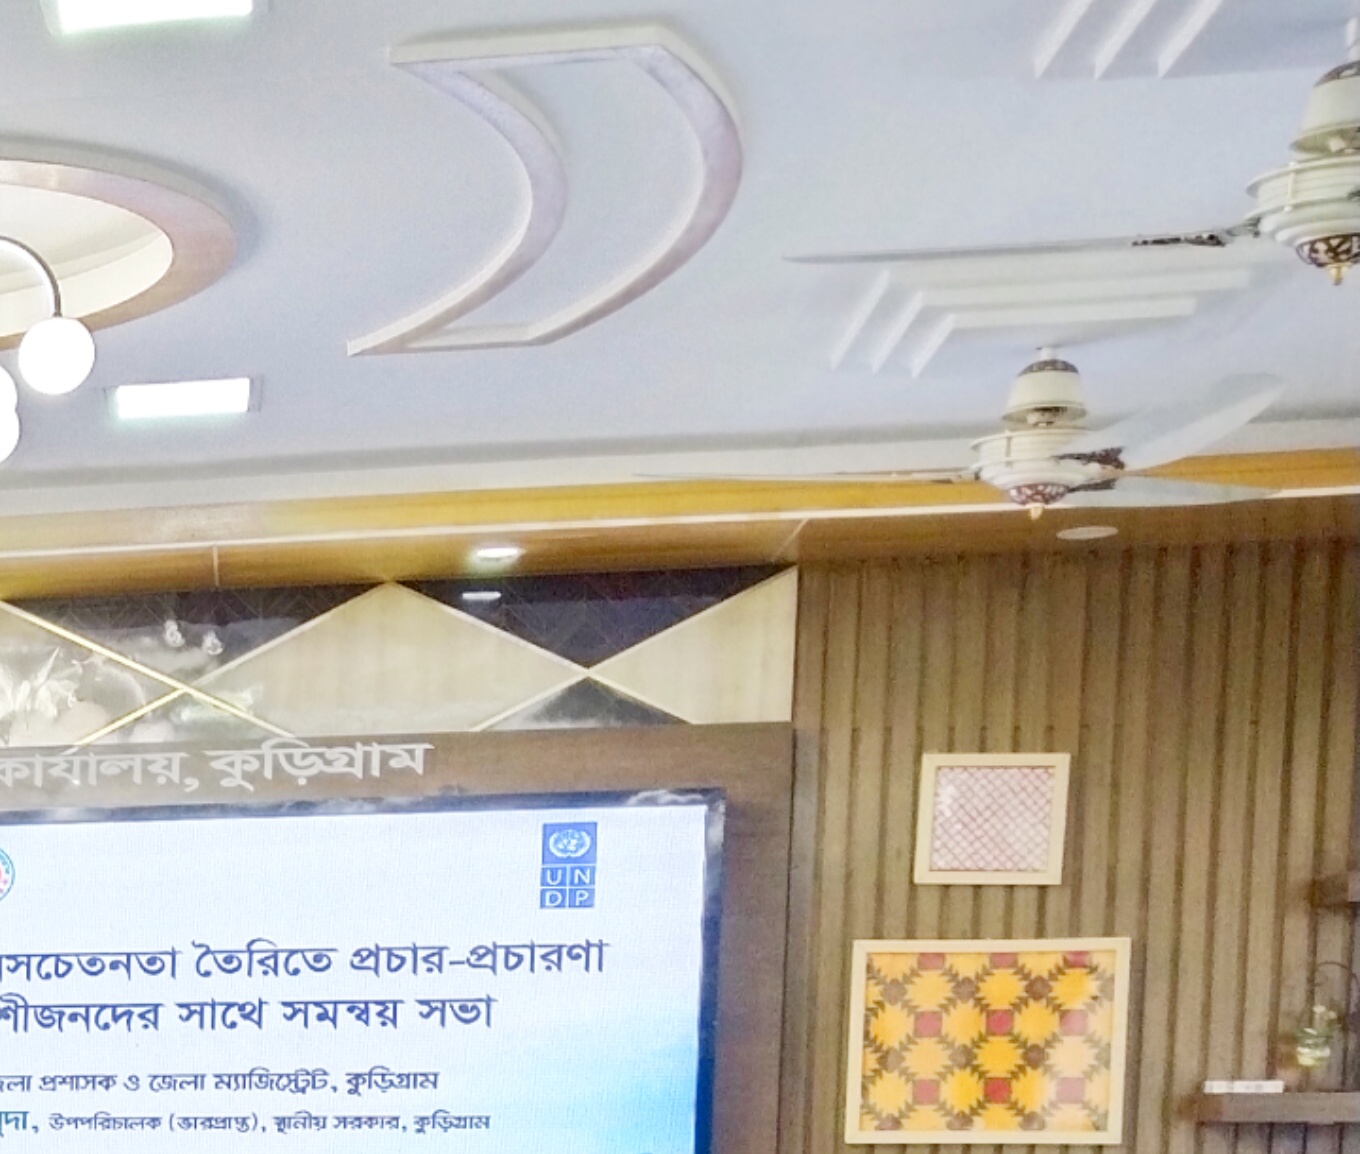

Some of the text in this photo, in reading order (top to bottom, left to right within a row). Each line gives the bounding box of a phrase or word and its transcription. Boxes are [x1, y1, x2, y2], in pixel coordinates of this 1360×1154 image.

[203, 739, 436, 793] কুড়িগ্রাম
[194, 938, 336, 977] তৈরিতে
[348, 938, 609, 976] প্রচার-প্রচারণা
[178, 998, 268, 1032] সাথে
[282, 997, 399, 1031] সমন্বয়
[417, 995, 494, 1028] সভা
[39, 1073, 116, 1093] প্রশাসক
[124, 1076, 140, 1093] ও
[148, 1072, 206, 1092] জেলা
[345, 1066, 439, 1096] কুড়িগ্রাম
[49, 1109, 162, 1131] উপপরিচালক
[333, 1114, 407, 1134] সরকার,
[413, 1109, 492, 1134] কুড়িগ্রাম
